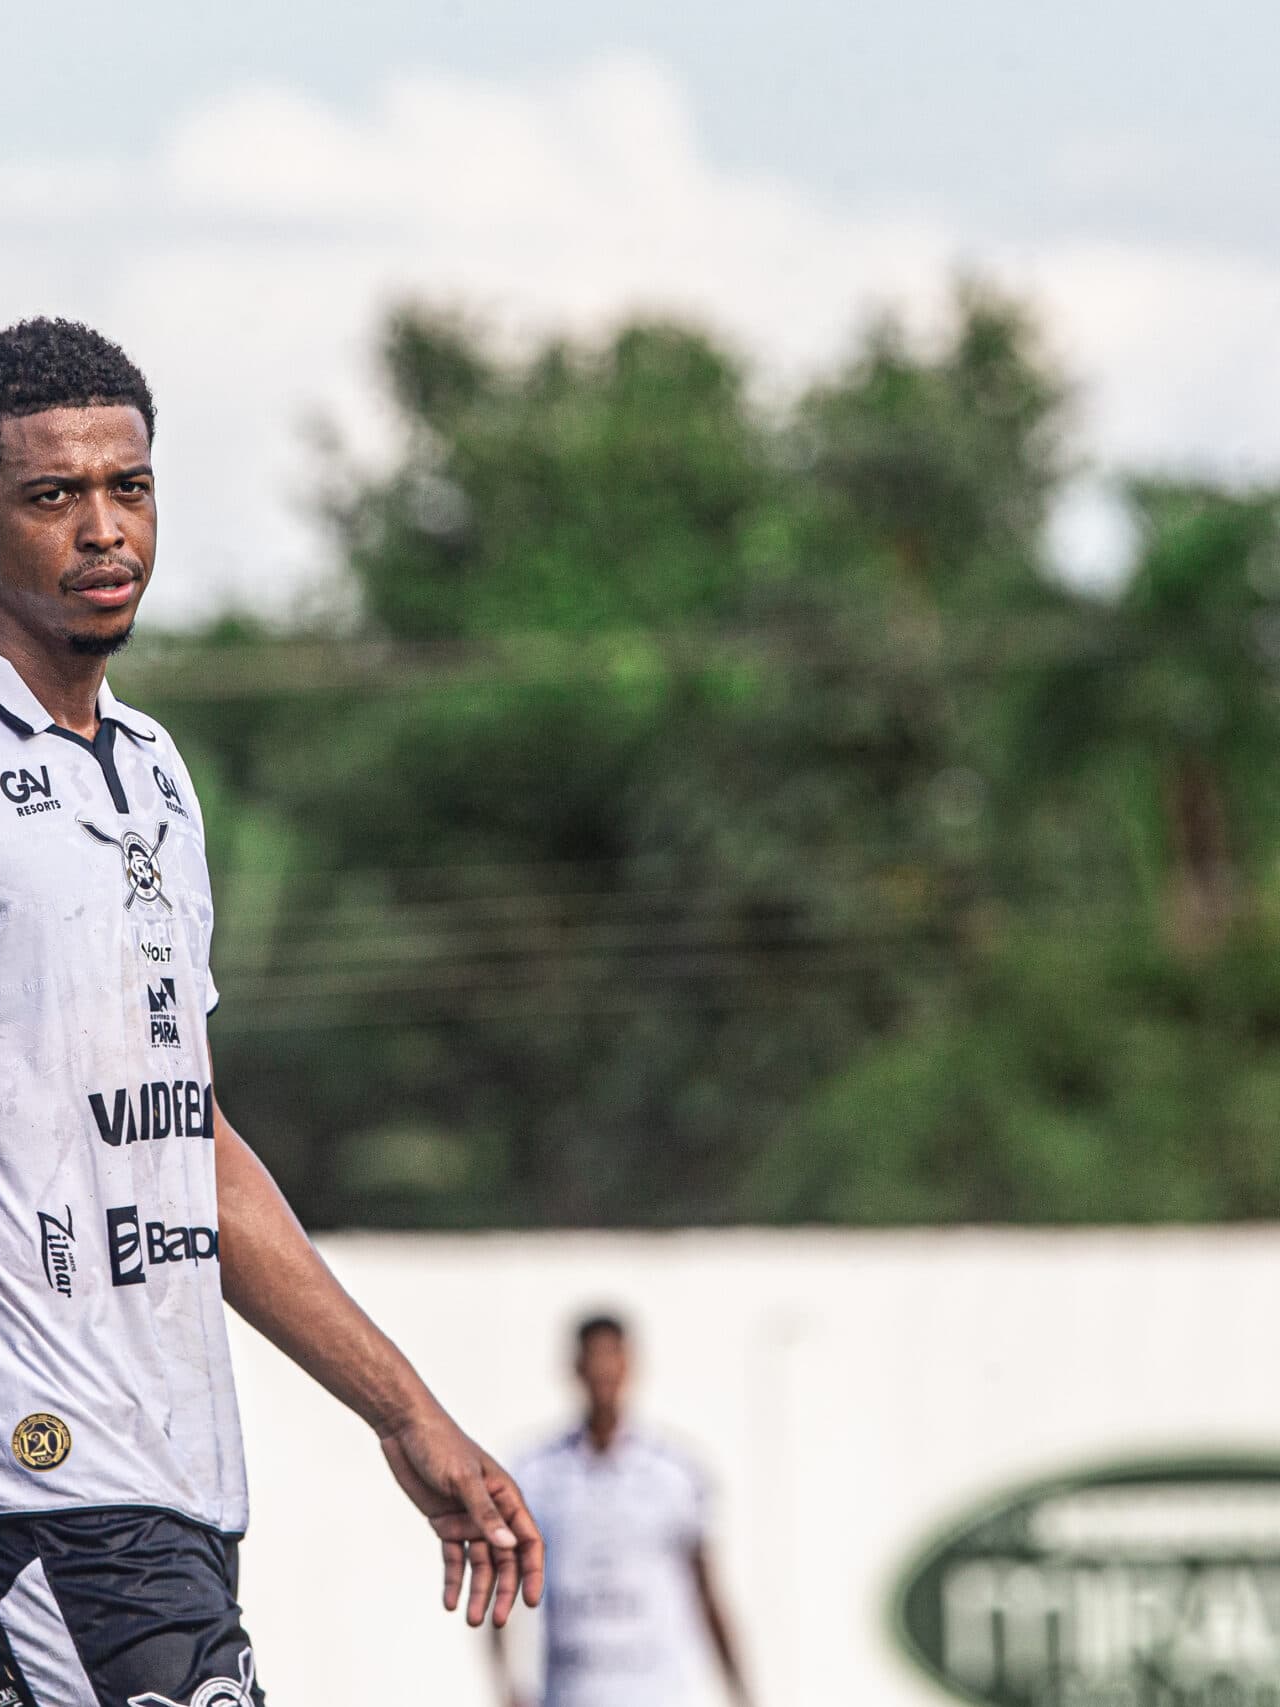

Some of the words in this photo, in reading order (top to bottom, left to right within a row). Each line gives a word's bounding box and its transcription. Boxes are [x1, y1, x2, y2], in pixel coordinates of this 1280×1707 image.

[0, 765, 52, 804] GAV
[16, 799, 62, 818] RESORTS
[141, 942, 172, 963] VOLT
[36, 1204, 76, 1299] Zilmar
[19, 1429, 62, 1457] 120
